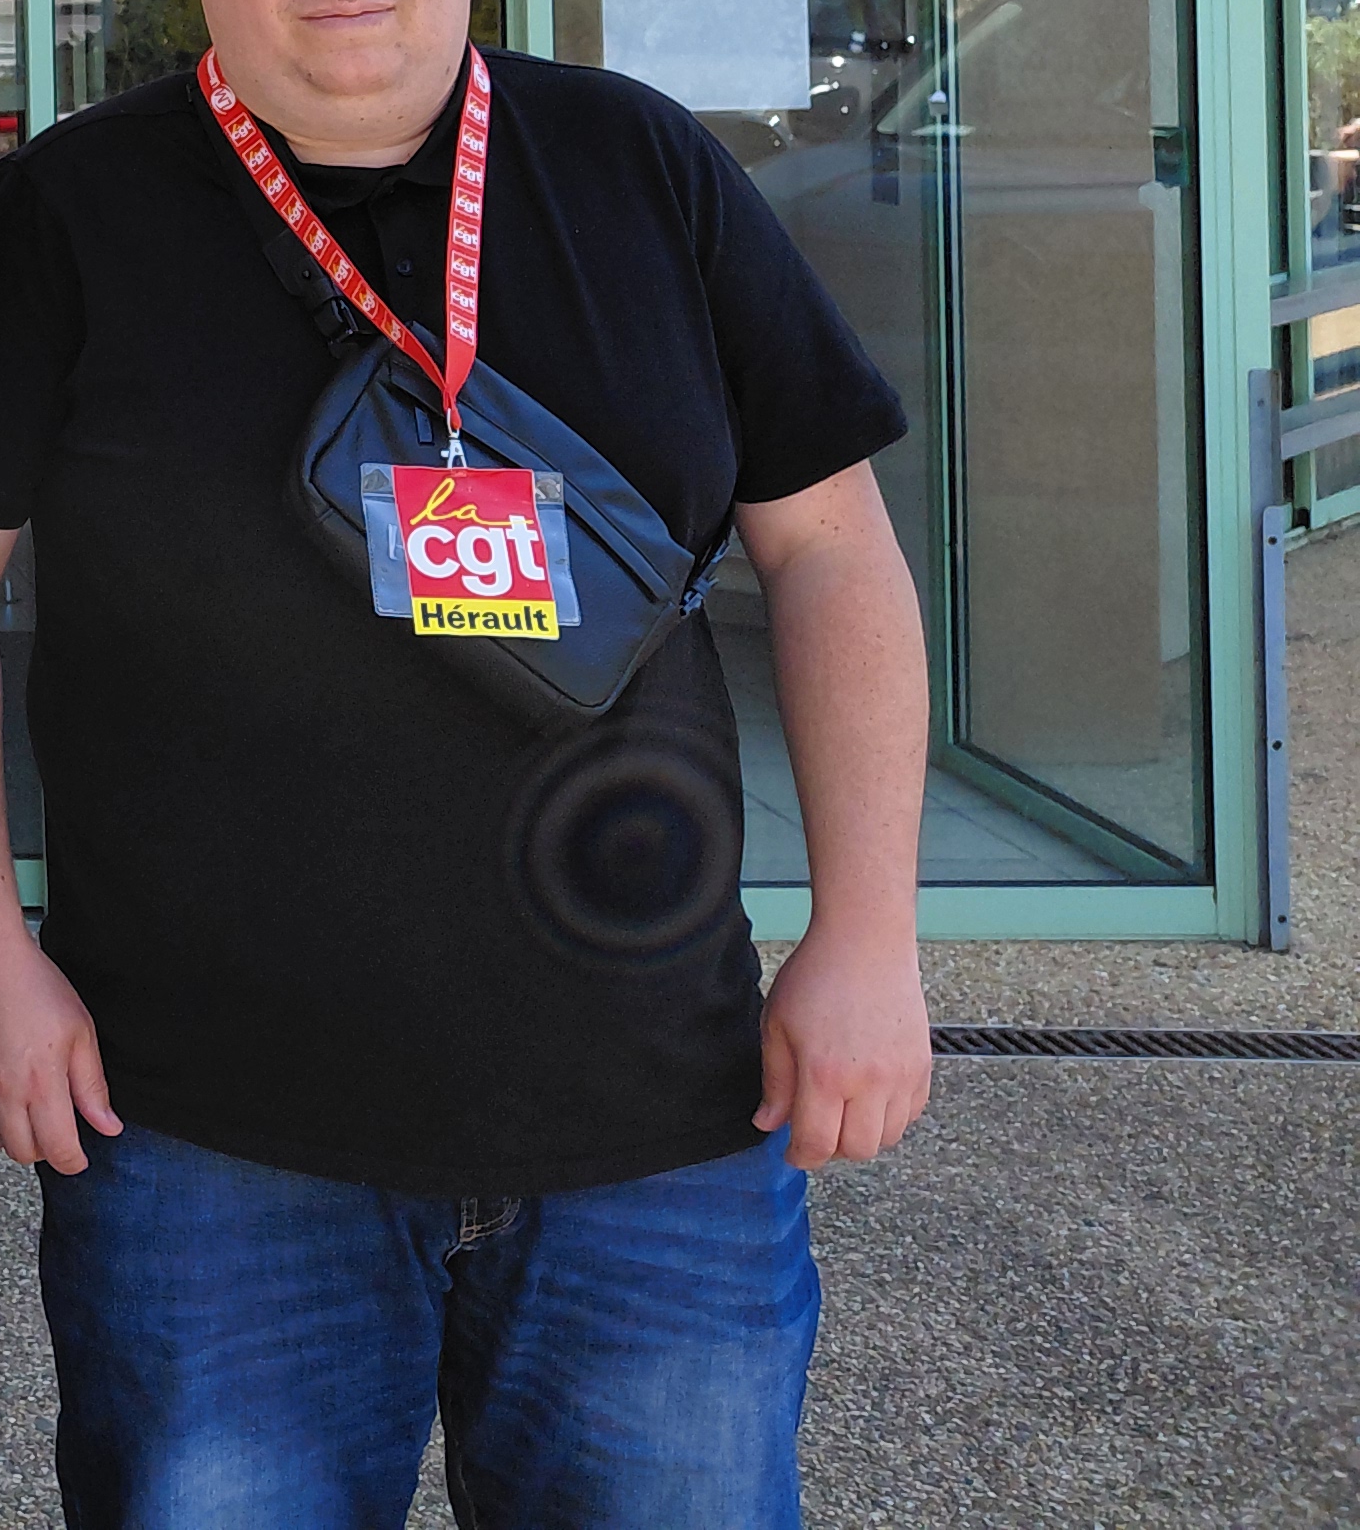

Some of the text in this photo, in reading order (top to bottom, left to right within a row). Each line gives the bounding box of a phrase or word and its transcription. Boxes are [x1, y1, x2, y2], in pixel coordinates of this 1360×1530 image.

[410, 478, 534, 526] la
[407, 515, 545, 596] cgt
[420, 602, 549, 631] Hérault
